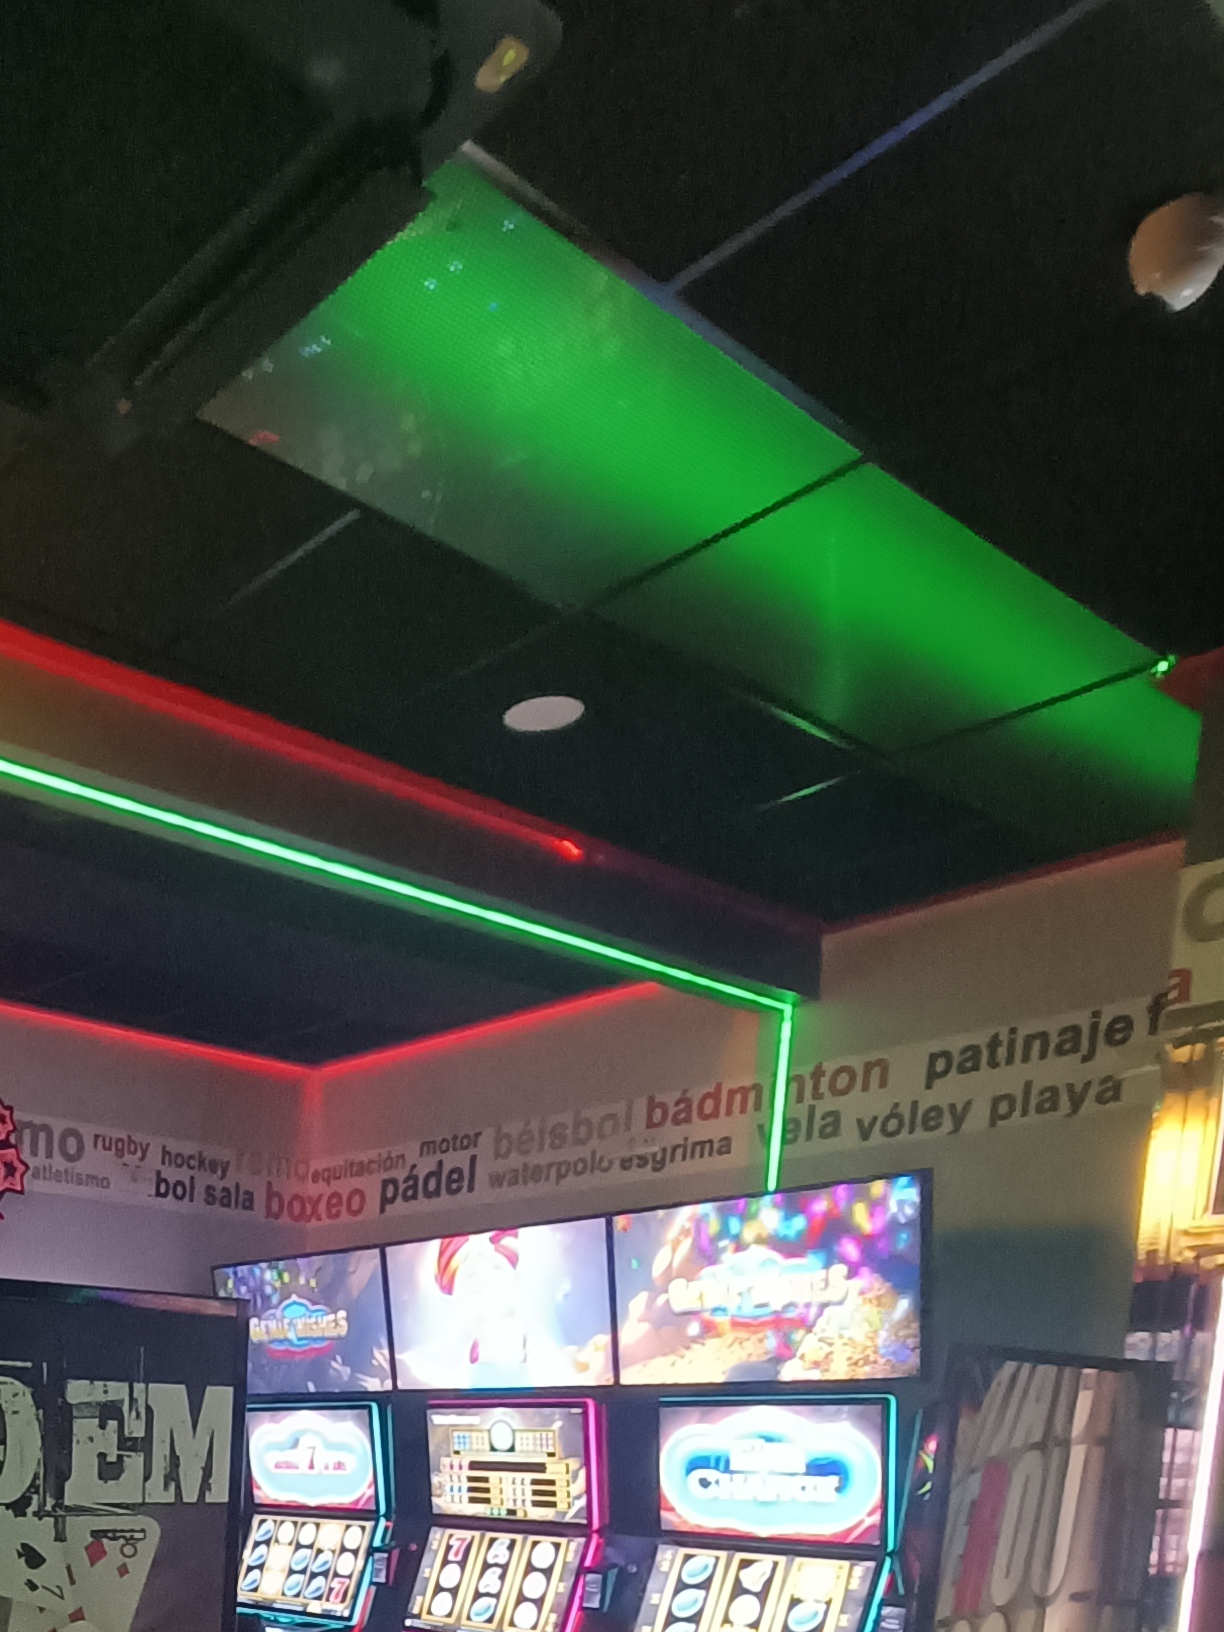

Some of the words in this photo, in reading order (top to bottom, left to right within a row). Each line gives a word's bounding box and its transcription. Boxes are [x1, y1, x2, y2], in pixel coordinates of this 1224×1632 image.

[644, 1055, 890, 1131] bádmnton
[925, 1008, 1134, 1088] patinaje
[856, 1095, 973, 1143] vóley
[988, 1071, 1124, 1130] playa
[32, 1163, 111, 1190] atletismo
[204, 1181, 255, 1212] sala
[264, 1182, 367, 1224] boxeo
[379, 1153, 478, 1214] pádel
[93, 1131, 151, 1162] rugby
[161, 1144, 231, 1181] hockey
[311, 1151, 406, 1187] equitación
[419, 1129, 483, 1159] motor
